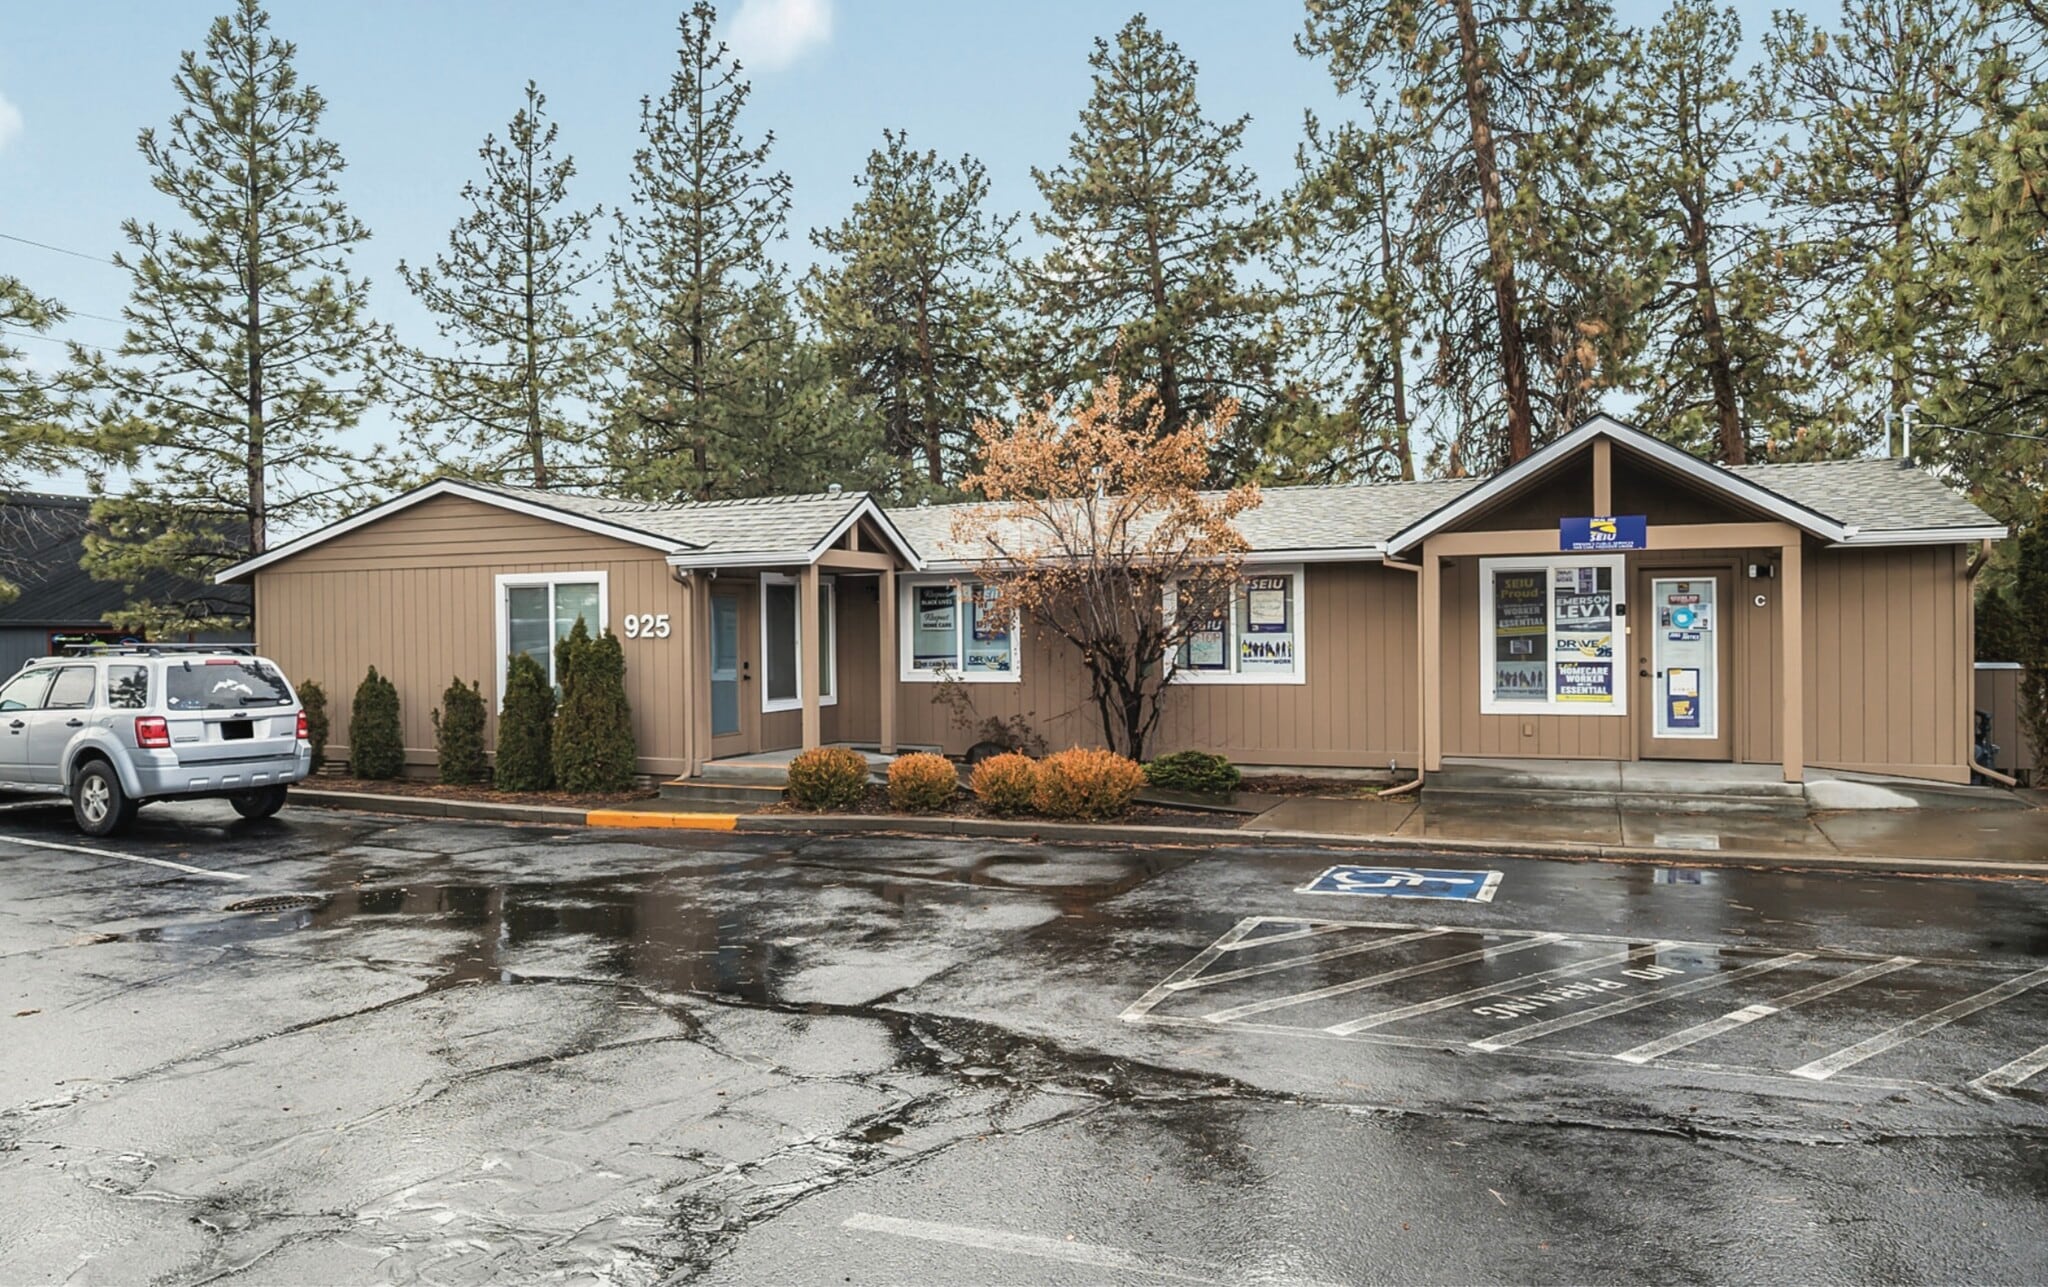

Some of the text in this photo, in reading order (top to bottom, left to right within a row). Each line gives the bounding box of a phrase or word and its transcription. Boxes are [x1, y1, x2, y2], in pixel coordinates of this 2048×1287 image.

[1589, 532, 1616, 542] SEIU
[1251, 578, 1284, 589] SEIU
[1504, 578, 1534, 589] SEIU
[1501, 588, 1539, 599] Proud
[1556, 595, 1610, 606] EMERSON
[1754, 594, 1766, 607] C
[1503, 606, 1541, 616] WORKER
[1556, 603, 1609, 618] LEVY
[624, 614, 670, 638] 925
[1499, 617, 1544, 628] ESSENTIAL
[1559, 667, 1609, 675] HOMECARE
[1565, 675, 1604, 683] WORKER
[1560, 686, 1608, 694] ESSENTIAL
[1621, 965, 1685, 981] NO
[1472, 978, 1628, 1020] PARKING
